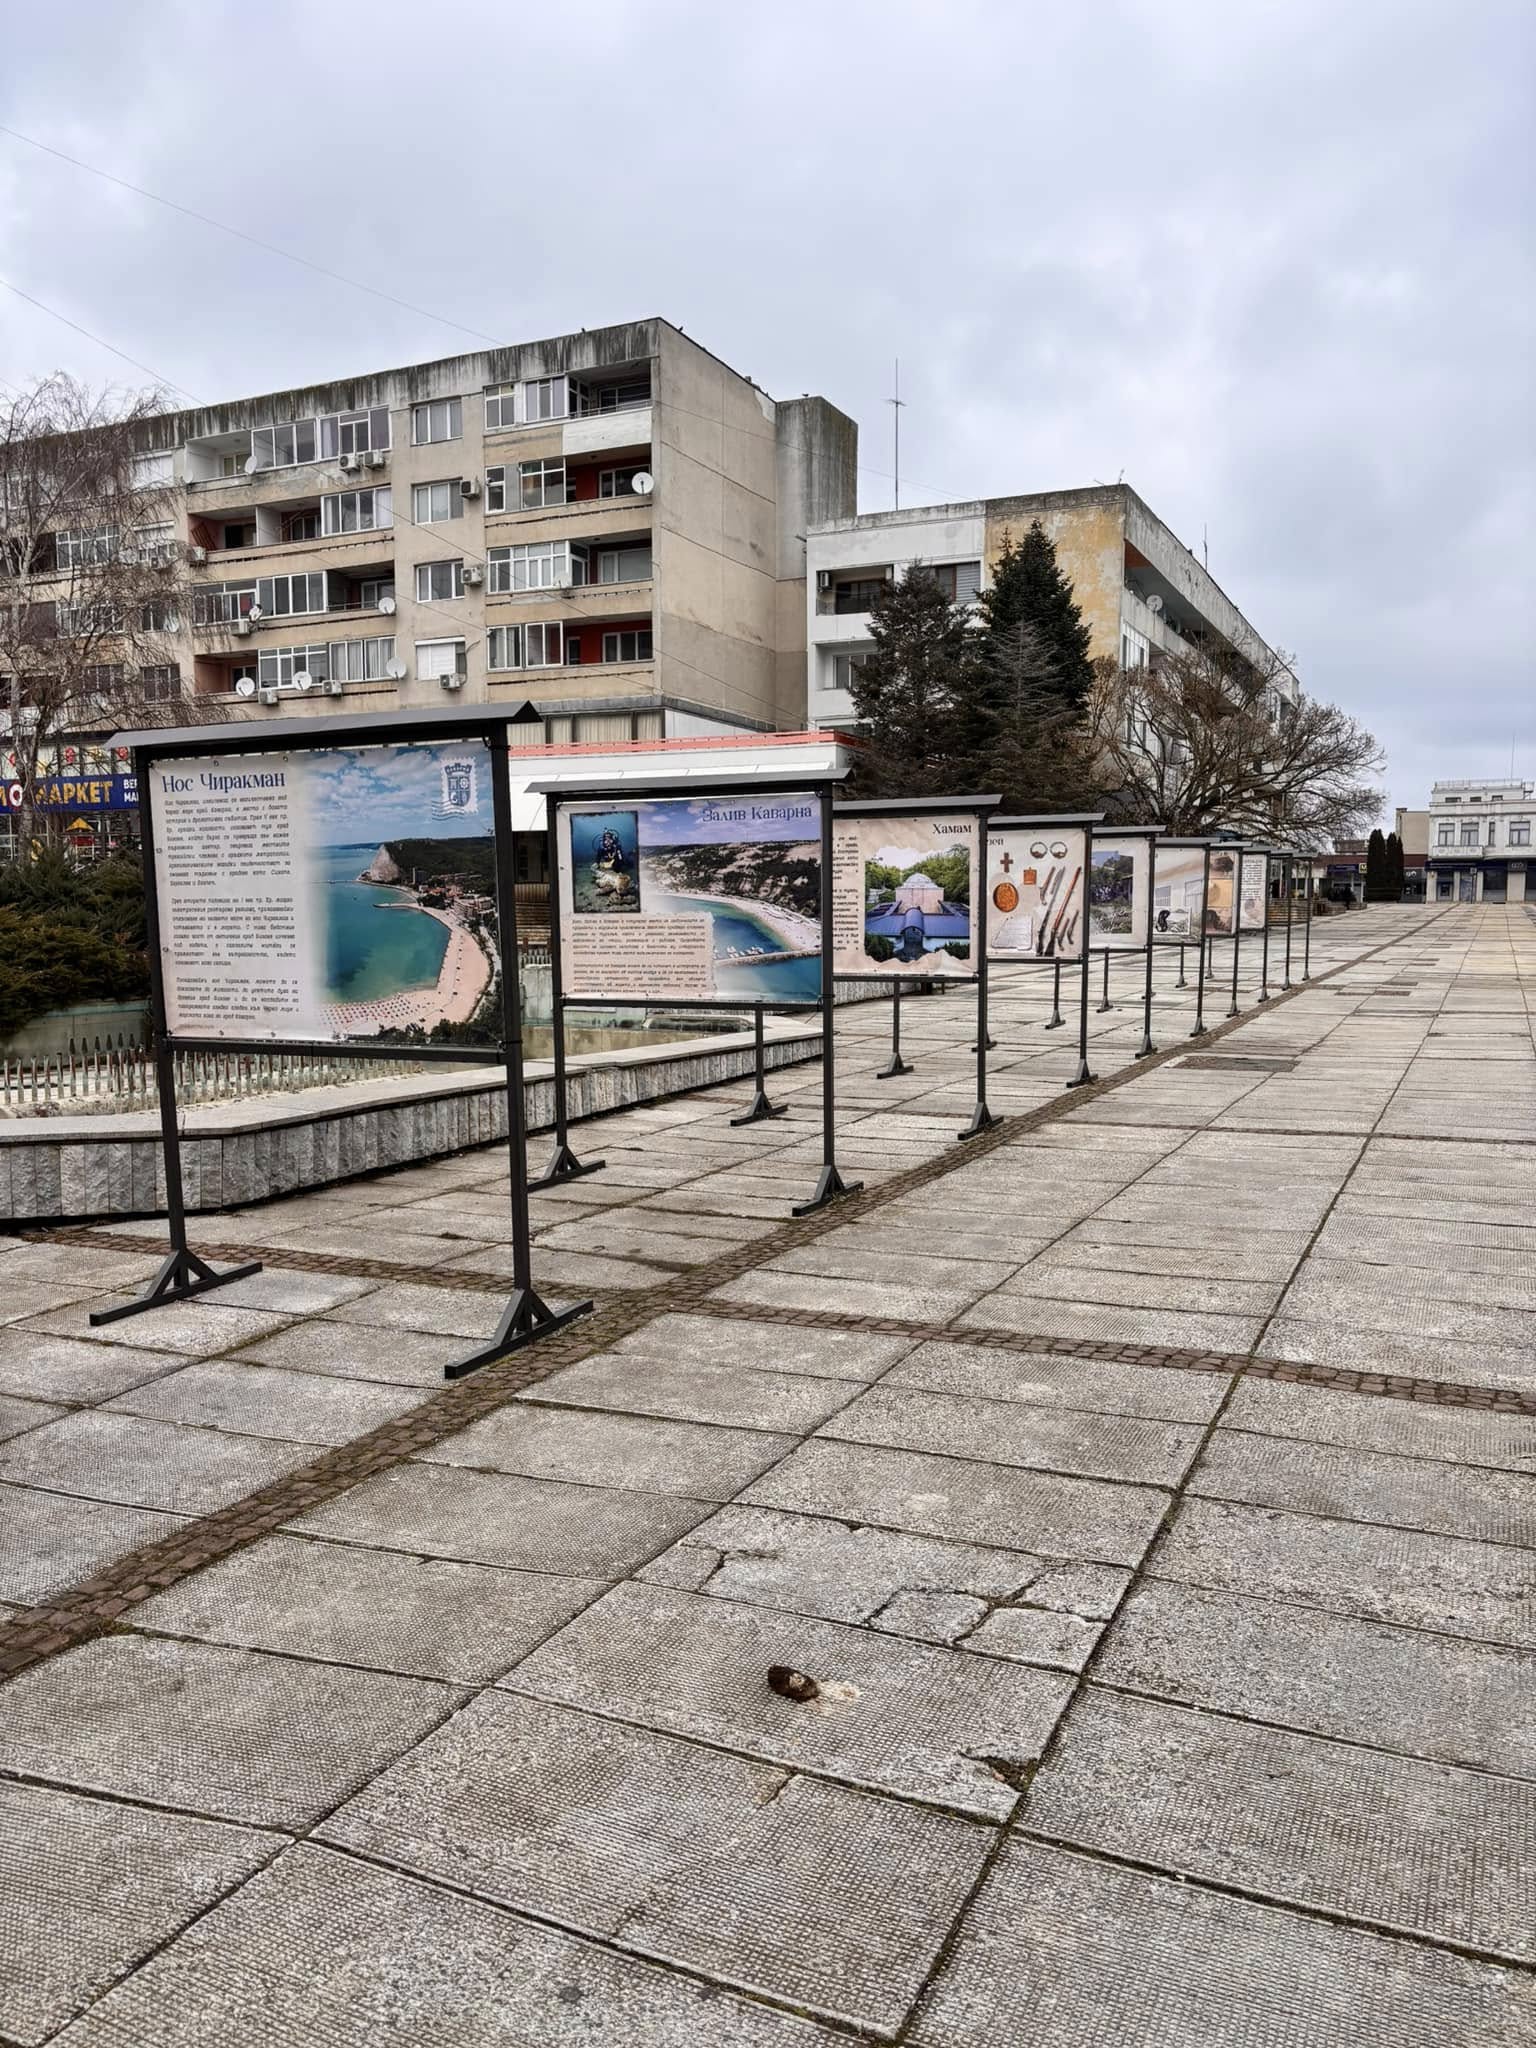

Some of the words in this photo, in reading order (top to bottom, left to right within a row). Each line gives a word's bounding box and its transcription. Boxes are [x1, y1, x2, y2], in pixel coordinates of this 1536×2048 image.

[161, 775, 194, 793] Нос
[200, 772, 285, 793] Чиракман
[702, 807, 746, 822] Залив
[751, 805, 812, 821] Каварна
[932, 823, 972, 834] Хамам
